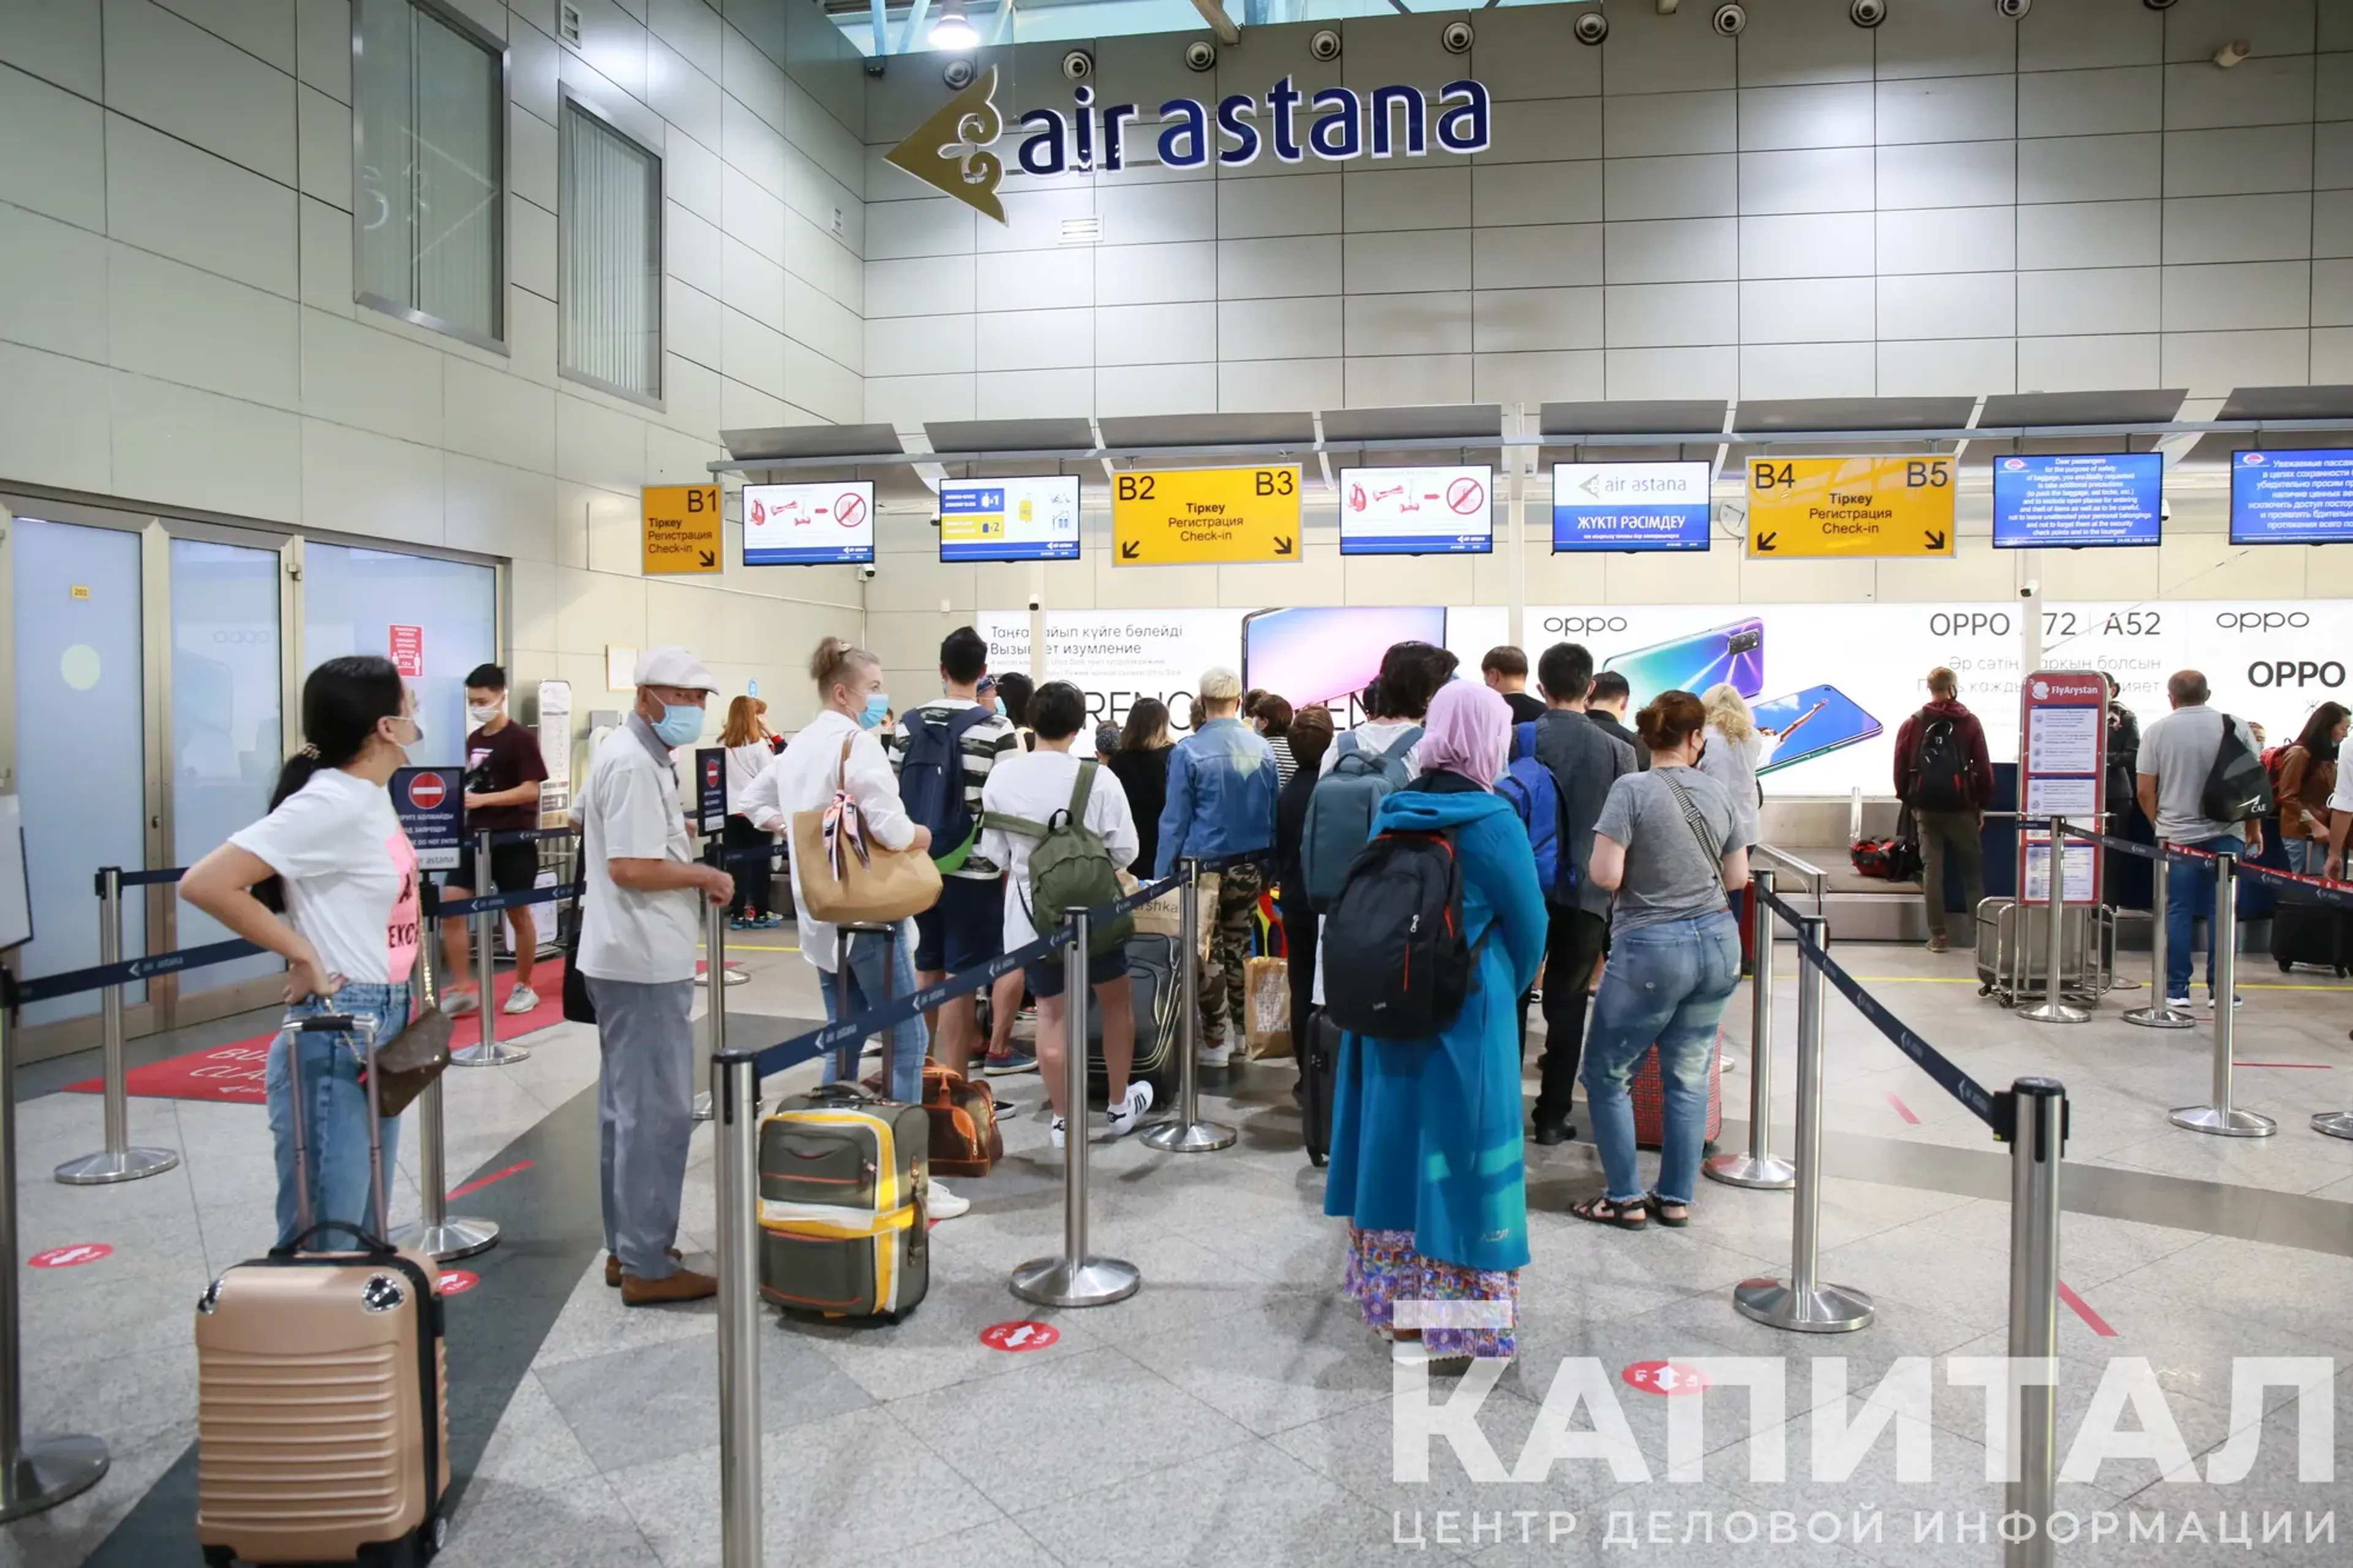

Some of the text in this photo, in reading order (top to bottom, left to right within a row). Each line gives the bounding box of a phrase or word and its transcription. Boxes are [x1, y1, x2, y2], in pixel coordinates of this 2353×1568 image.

[1018, 74, 1491, 177] air astana
[1756, 463, 1795, 489] B4
[1908, 461, 1947, 487] B5
[1119, 476, 1155, 500] B2
[1256, 471, 1293, 496] B3
[1605, 477, 1686, 491] air astana
[688, 490, 716, 512] B1
[1829, 493, 1873, 506] Тіркеу
[1186, 503, 1225, 515] Тіркеу
[1809, 509, 1892, 520] Регистрация
[648, 518, 683, 529] Тіркеу
[1168, 516, 1243, 530] Регистрация
[1578, 515, 1686, 531] ЖҮКТІ РӘСІМДЕУ
[1822, 523, 1879, 534] Check-in
[648, 530, 712, 542] Регистрация
[1180, 529, 1232, 542] Check-in
[648, 543, 692, 553] Check-in
[1544, 616, 1627, 637] oppo
[1930, 613, 2010, 636] OPPO
[2104, 612, 2161, 635] A52
[2216, 612, 2309, 632] oppo
[1083, 623, 1183, 640] күйге бөлейді
[1064, 643, 1142, 657] изумление
[1949, 656, 2161, 672] Әр сәтің арқын болсын
[2248, 661, 2346, 687] OPPO
[2052, 685, 2098, 696] FlyArystan
[2122, 682, 2159, 693] ияет
[2251, 803, 2267, 812] CAE
[1135, 900, 1178, 914] rshka
